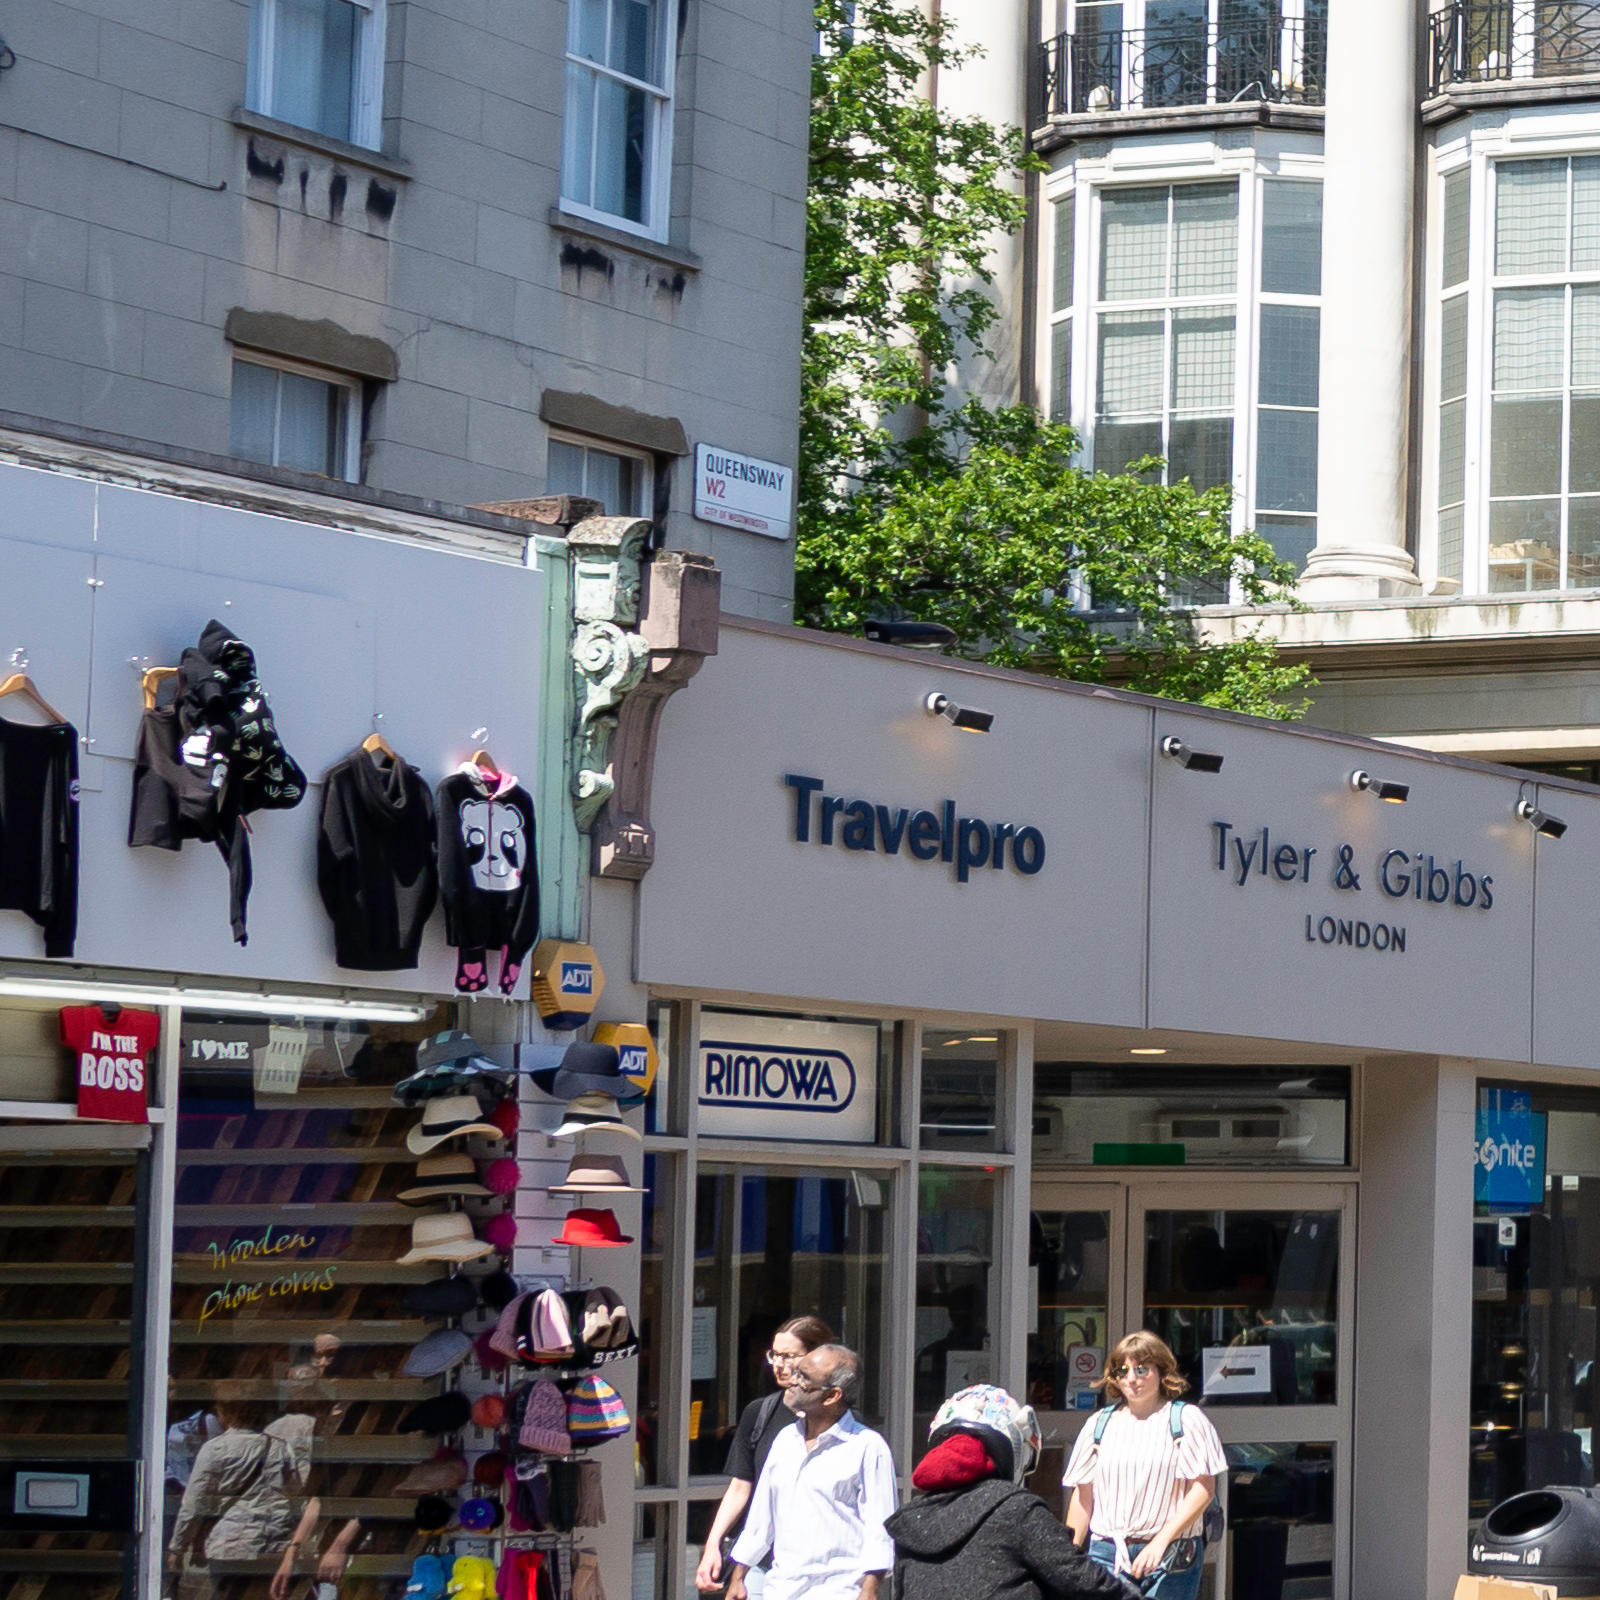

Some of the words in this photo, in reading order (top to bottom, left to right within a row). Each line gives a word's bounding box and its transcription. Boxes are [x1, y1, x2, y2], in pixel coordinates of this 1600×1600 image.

[705, 476, 726, 499] W2
[706, 453, 785, 491] QUEENSWAY
[784, 773, 1046, 884] Travelpro
[1213, 821, 1318, 887] Tyler
[1335, 843, 1361, 891] &
[1381, 849, 1494, 910] Gibbs
[1306, 914, 1406, 952] LONDON
[560, 968, 593, 988] ADT
[91, 1031, 112, 1051] I'M
[114, 1035, 138, 1053] THE
[216, 1041, 249, 1060] ME
[618, 1050, 648, 1071] ADT
[79, 1052, 144, 1092] BOSS
[705, 1052, 838, 1102] RIMOWA
[197, 1279, 263, 1335] phone
[268, 1265, 337, 1297] covers
[592, 1344, 637, 1364] SEXY
